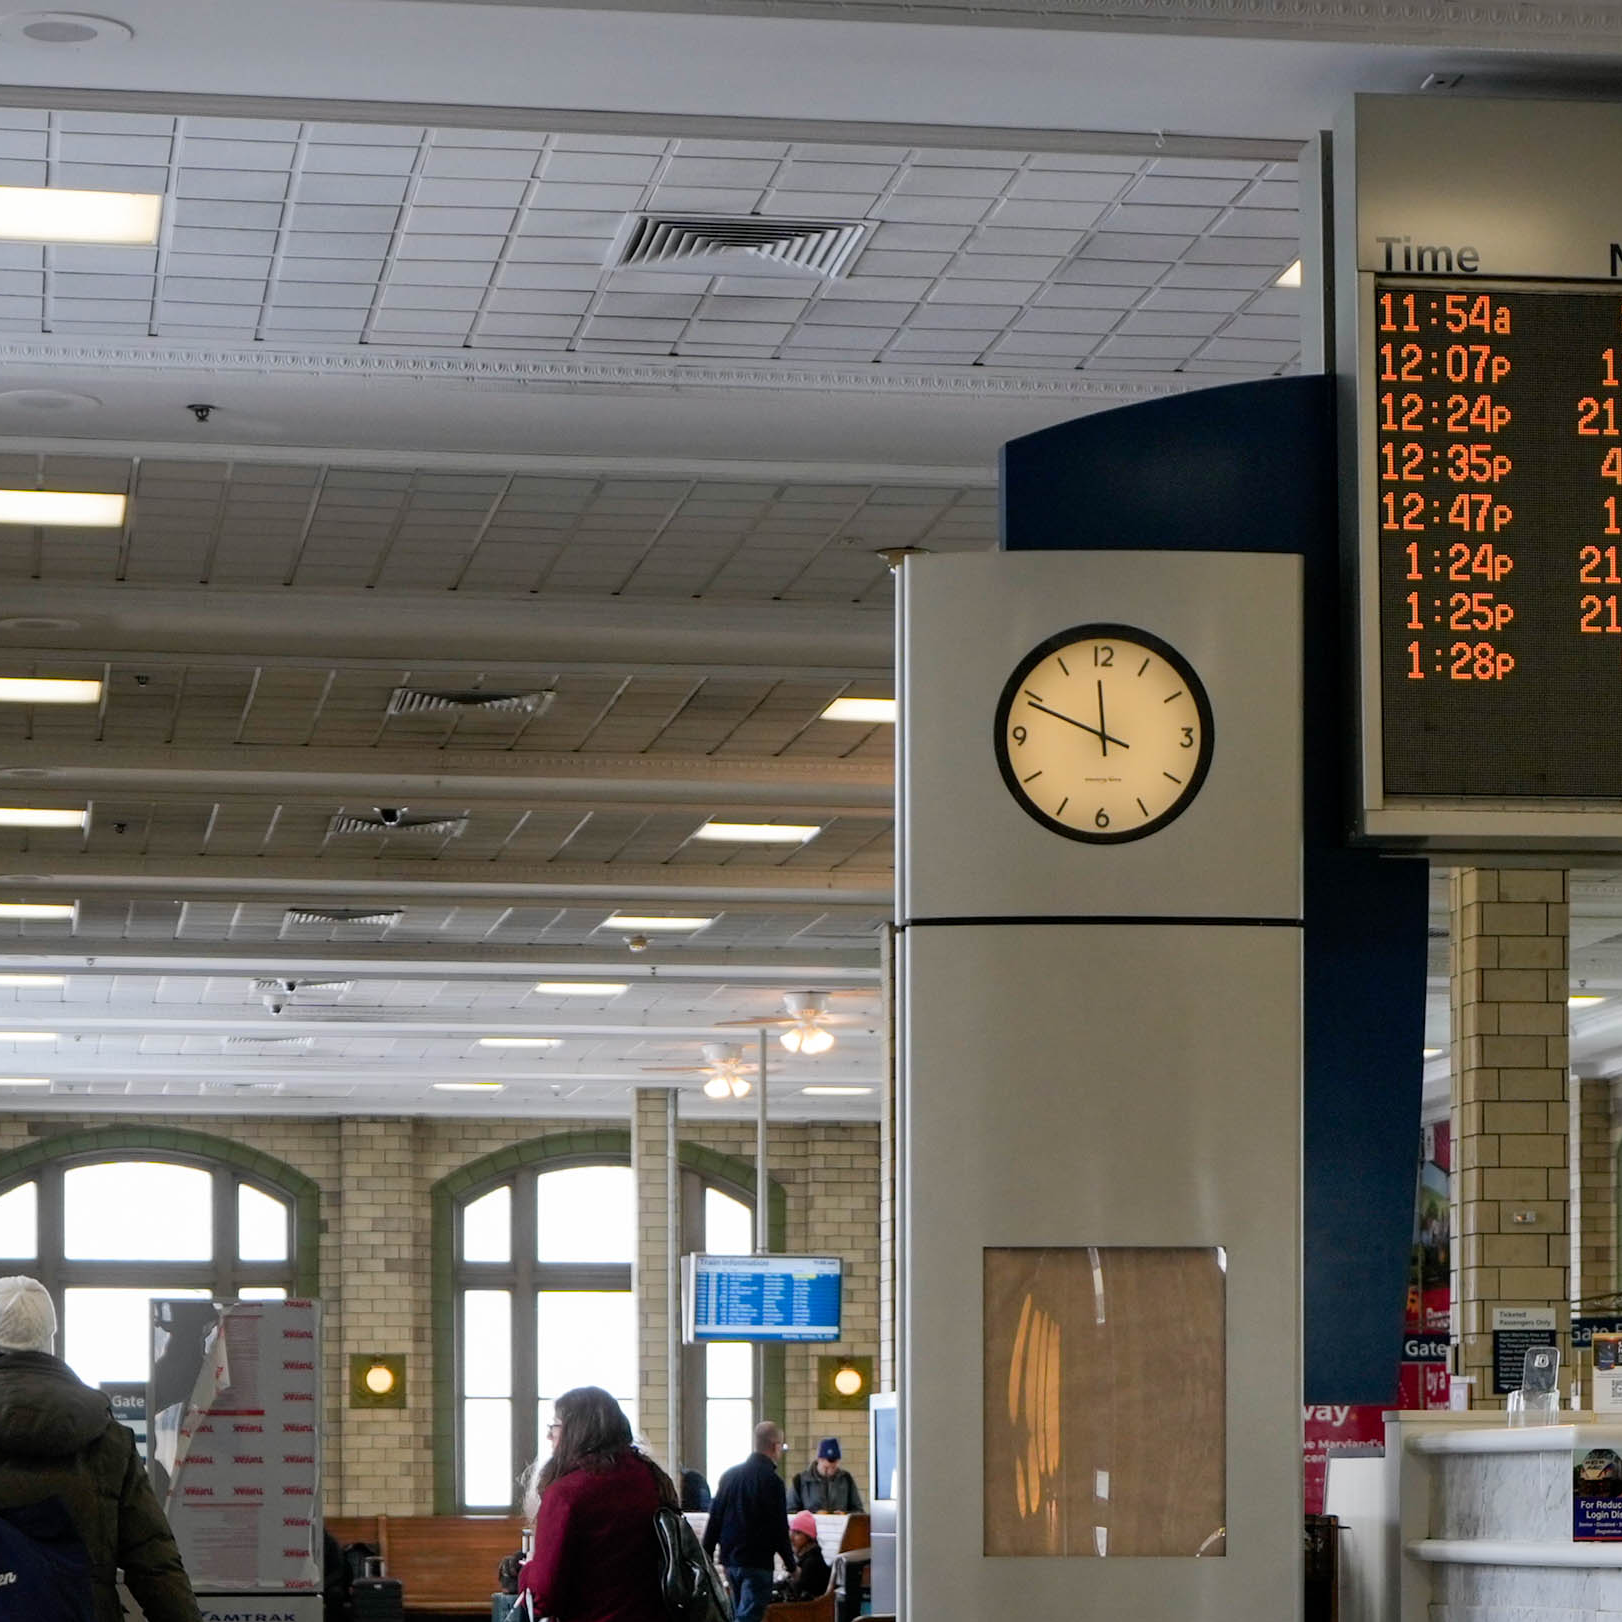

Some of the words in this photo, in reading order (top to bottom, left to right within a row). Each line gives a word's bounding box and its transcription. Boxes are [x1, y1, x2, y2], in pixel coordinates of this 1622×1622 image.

[1376, 236, 1481, 273] Time
[1379, 292, 1512, 336] 11:54a
[1379, 341, 1512, 385] 12:07p
[1380, 391, 1513, 434] 12:24p
[1380, 441, 1513, 484] 12:35p
[1381, 490, 1514, 534] 12:47p
[1405, 540, 1515, 583] 1:24p
[1405, 590, 1516, 632] 1:25p
[1093, 645, 1115, 668] 12
[1407, 639, 1516, 682] 1:28p
[1011, 725, 1028, 747] 9
[1178, 727, 1194, 749] 3
[1094, 807, 1110, 829] 6
[1404, 1340, 1447, 1357] Gate
[111, 1394, 145, 1408] Gate
[1580, 1500, 1595, 1509] For
[1585, 1510, 1610, 1521] Login
[209, 1612, 296, 1622] AMTRAK
